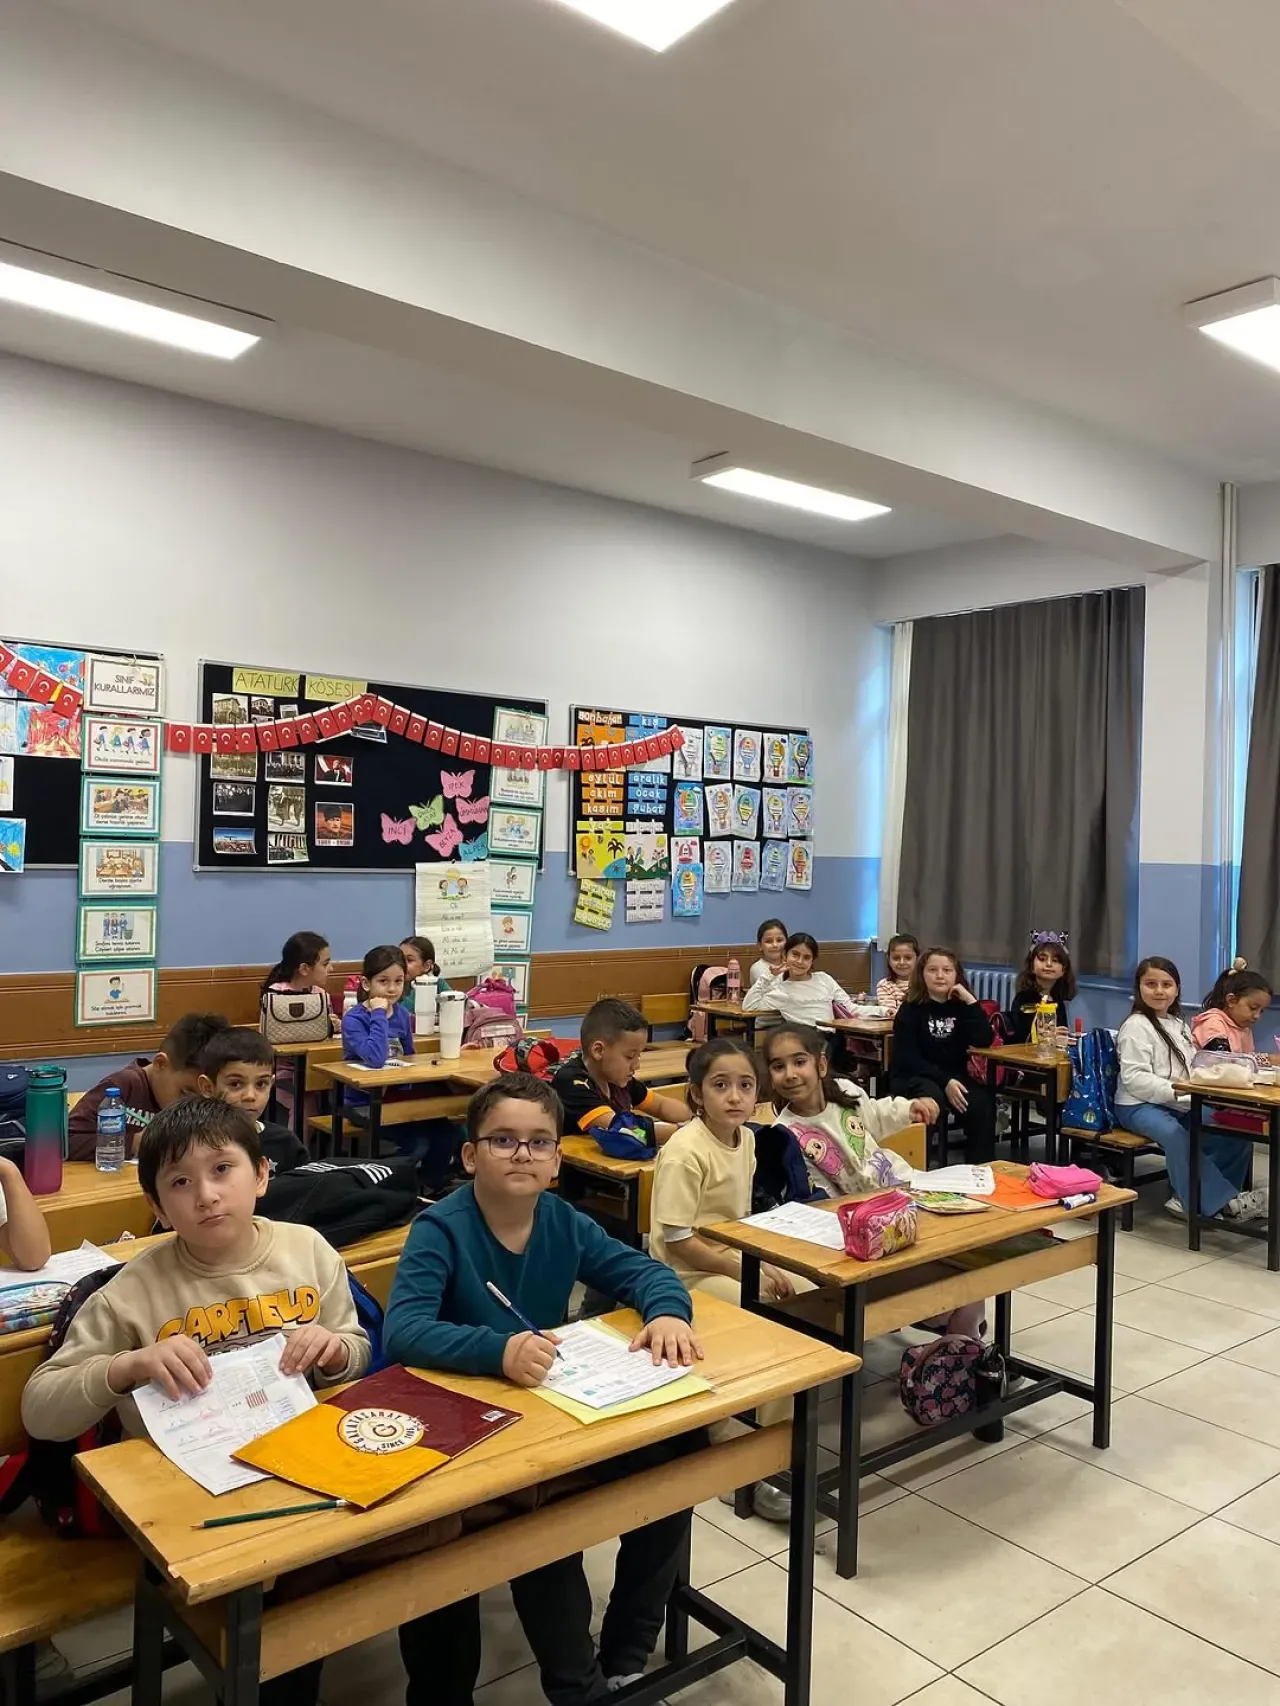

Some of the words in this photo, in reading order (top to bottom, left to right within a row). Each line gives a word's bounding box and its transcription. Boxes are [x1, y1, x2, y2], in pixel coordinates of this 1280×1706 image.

[114, 674, 135, 684] SINIF
[94, 683, 155, 697] KURALLARIMIZ
[635, 788, 661, 798] ocak
[381, 1440, 404, 1449] SINCE
